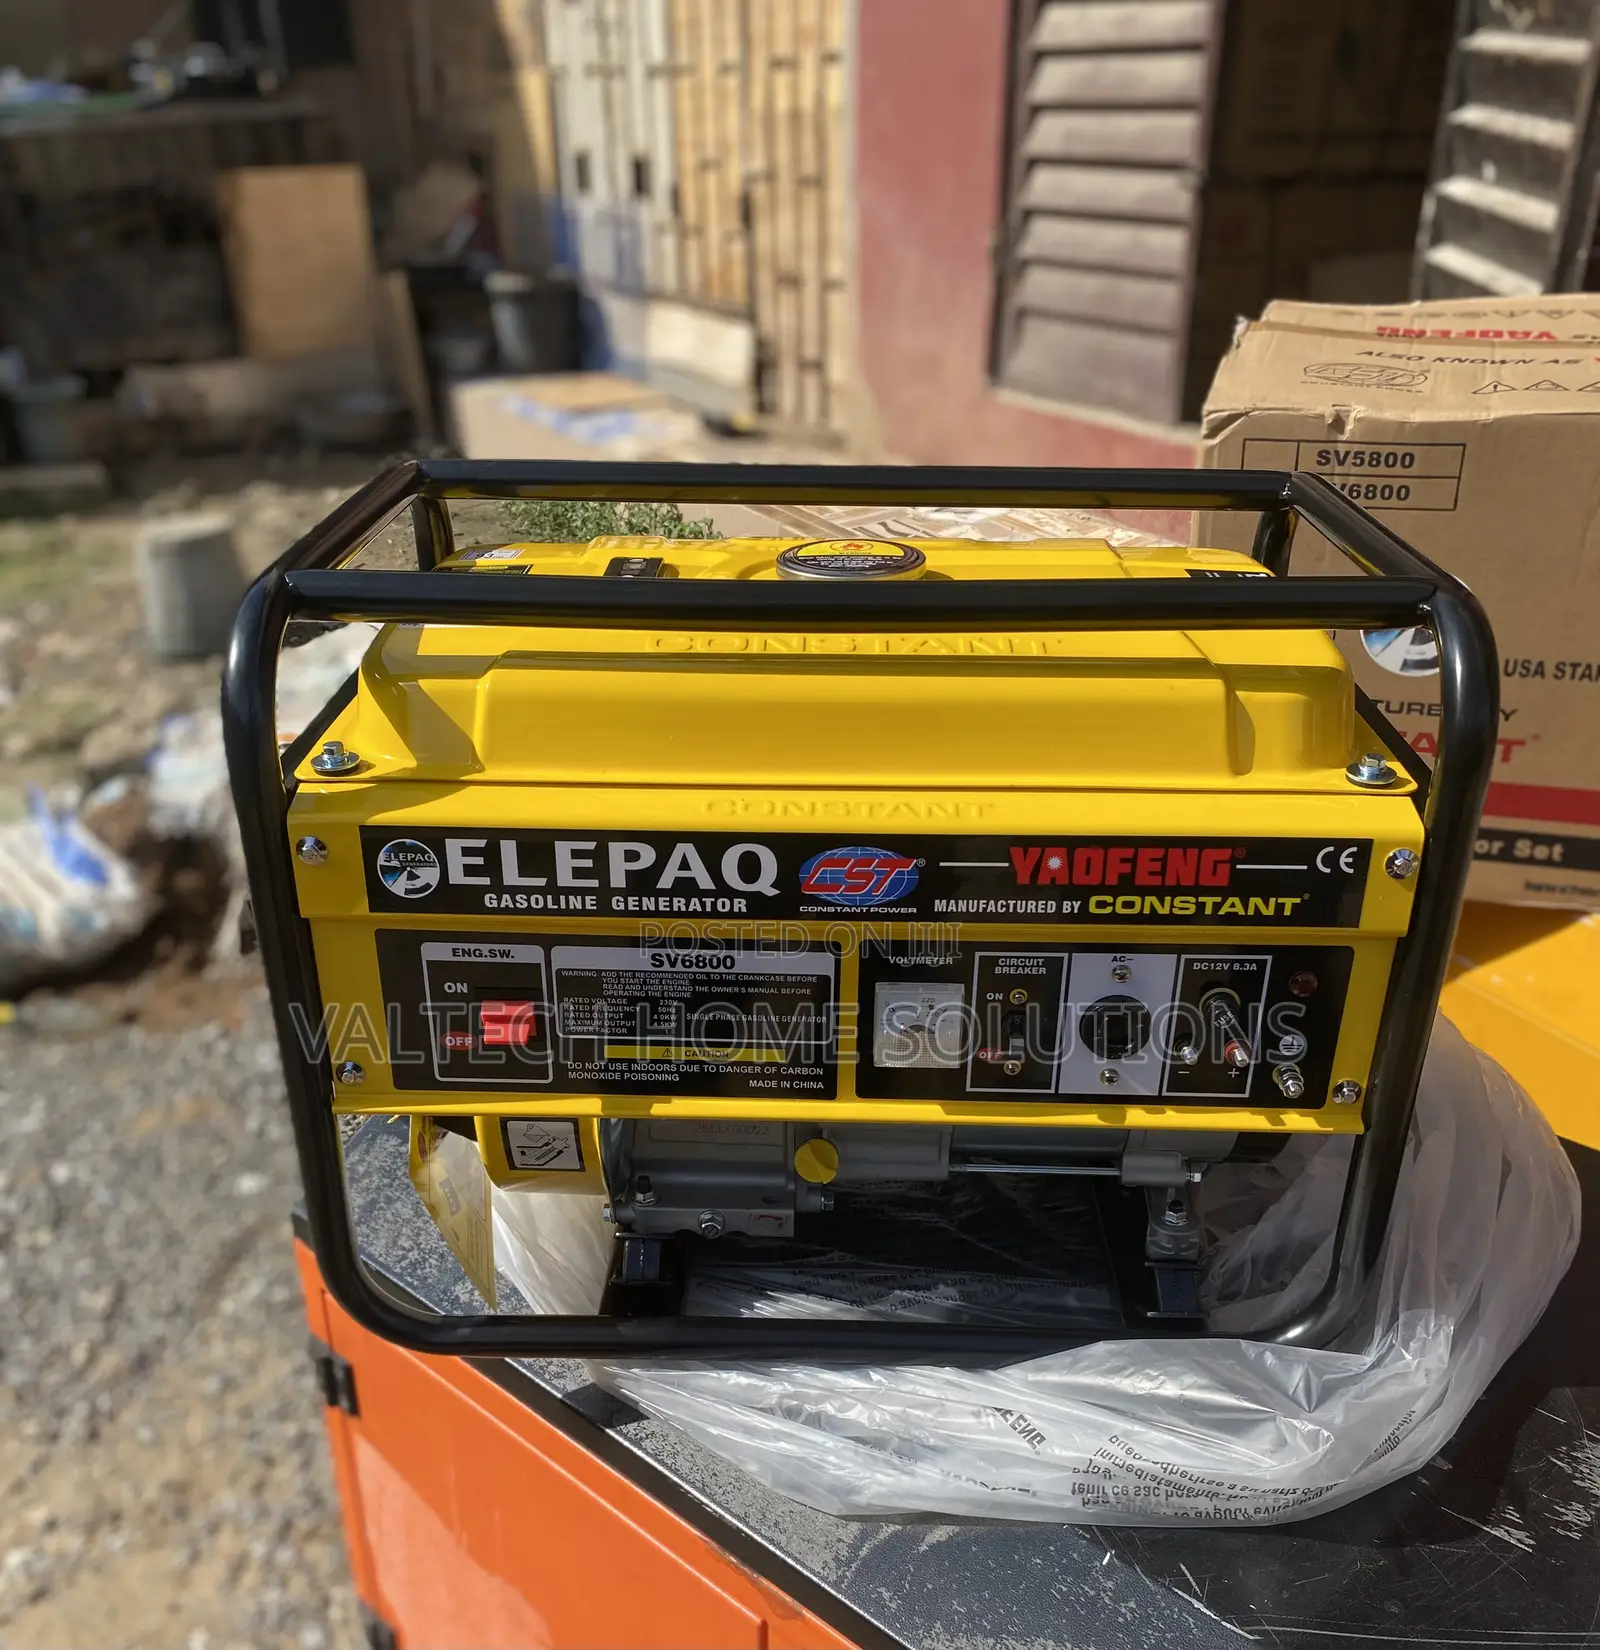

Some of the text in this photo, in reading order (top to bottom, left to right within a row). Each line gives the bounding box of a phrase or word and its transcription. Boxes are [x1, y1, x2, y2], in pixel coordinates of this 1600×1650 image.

[1356, 350, 1425, 361] ALSO
[1432, 356, 1535, 365] KNOWN
[1316, 449, 1415, 469] SV5800
[1332, 483, 1410, 501] 6800
[646, 634, 1062, 655] CONSTANT
[1503, 658, 1546, 680] USA
[700, 799, 995, 818] CONSTANT
[1513, 837, 1564, 862] Set
[383, 852, 434, 862] ELEPAQ
[444, 838, 781, 897] ELEPAQ
[1009, 846, 1232, 886] YAOFENG
[801, 857, 916, 895] CST
[484, 893, 748, 914] GASOLINE GENERATOR
[933, 894, 1301, 916] MANUFACTURED BY CONSTANT
[799, 905, 917, 914] CONSTANT POWER
[451, 947, 515, 959] ENG.SW.
[650, 952, 736, 970] SV6800
[888, 956, 953, 965] VOLTMETER
[998, 958, 1045, 966] CIRCUIT
[994, 966, 1047, 975] BREAKER
[1192, 962, 1258, 971] DC12V 8.3A
[621, 977, 644, 985] START
[635, 972, 695, 980] RECOMMENDED
[722, 973, 736, 981] THE
[738, 974, 785, 983] CRANKCASE
[786, 975, 818, 983] BEFORE
[443, 981, 468, 993] ON
[602, 983, 622, 991] READ
[643, 984, 693, 992] UNDERSTAND
[695, 985, 709, 993] THE
[591, 997, 628, 1005] VOLTAGE
[986, 992, 1004, 1001] ON
[592, 1004, 640, 1013] FREQUENCY
[564, 1010, 590, 1018] RATED
[592, 1011, 624, 1019] OUTPUT
[686, 1013, 714, 1021] SINGLE
[742, 1014, 780, 1023] GASOLINE
[781, 1015, 827, 1024] GENERATOR
[564, 1018, 603, 1026] MAXIMUM
[604, 1019, 636, 1027] OUTPUT
[565, 1025, 593, 1033] POWER
[595, 1026, 628, 1034] FACTOR
[444, 1036, 473, 1047] OFF
[684, 1050, 729, 1059] CAUTION
[978, 1051, 1000, 1060] OFF
[567, 1062, 824, 1076] DO NOT USE INDOORS DUE TO DANGER OF CARBON
[568, 1071, 680, 1082] MONOXIDE POISONING
[749, 1079, 824, 1089] MADE IN CHINA
